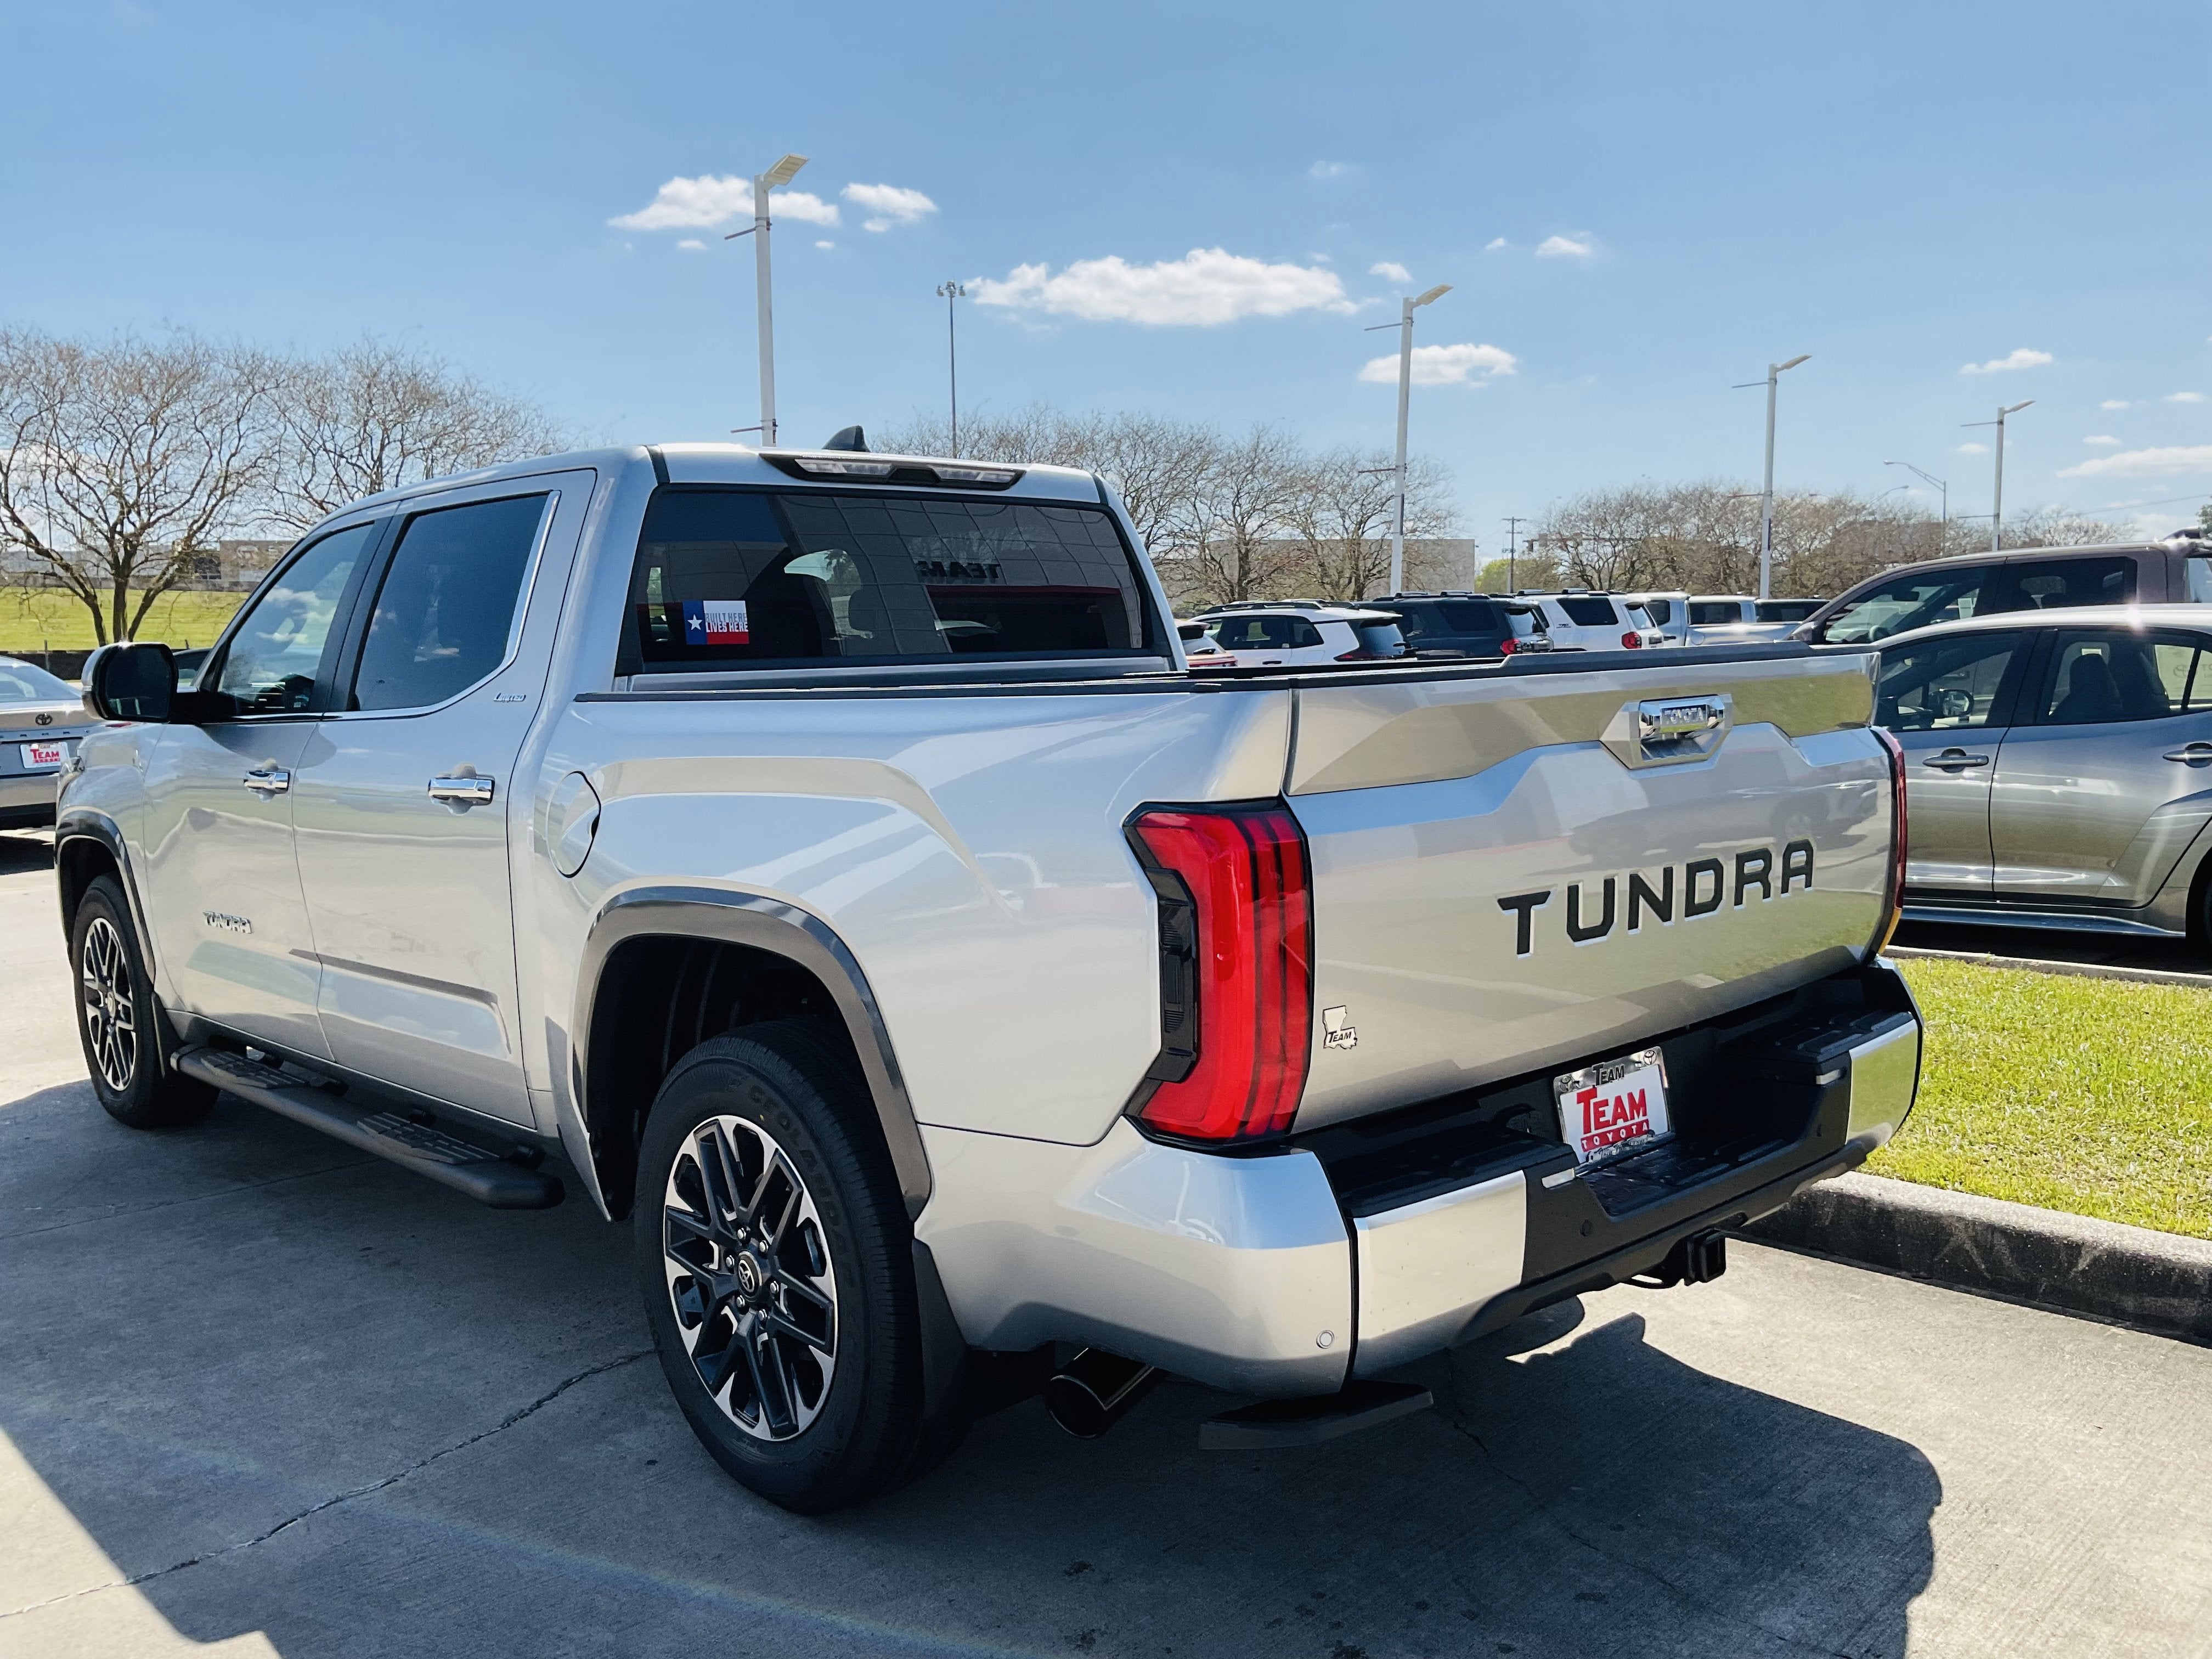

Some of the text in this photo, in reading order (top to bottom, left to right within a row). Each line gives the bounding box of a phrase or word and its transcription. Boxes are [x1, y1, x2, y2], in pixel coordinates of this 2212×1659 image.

[706, 612, 747, 622] BUILT HERE
[706, 622, 748, 633] LIVES HERE
[1664, 707, 1704, 725] TOYOTA
[30, 749, 59, 759] TEAM
[1497, 837, 1815, 956] TUNDRA
[202, 911, 253, 934] TUNDRA
[1328, 1030, 1352, 1043] TEAM
[1592, 1063, 1624, 1086] TEAM
[1576, 1087, 1647, 1135] TEAM
[1581, 1122, 1649, 1149] TOYOTA
